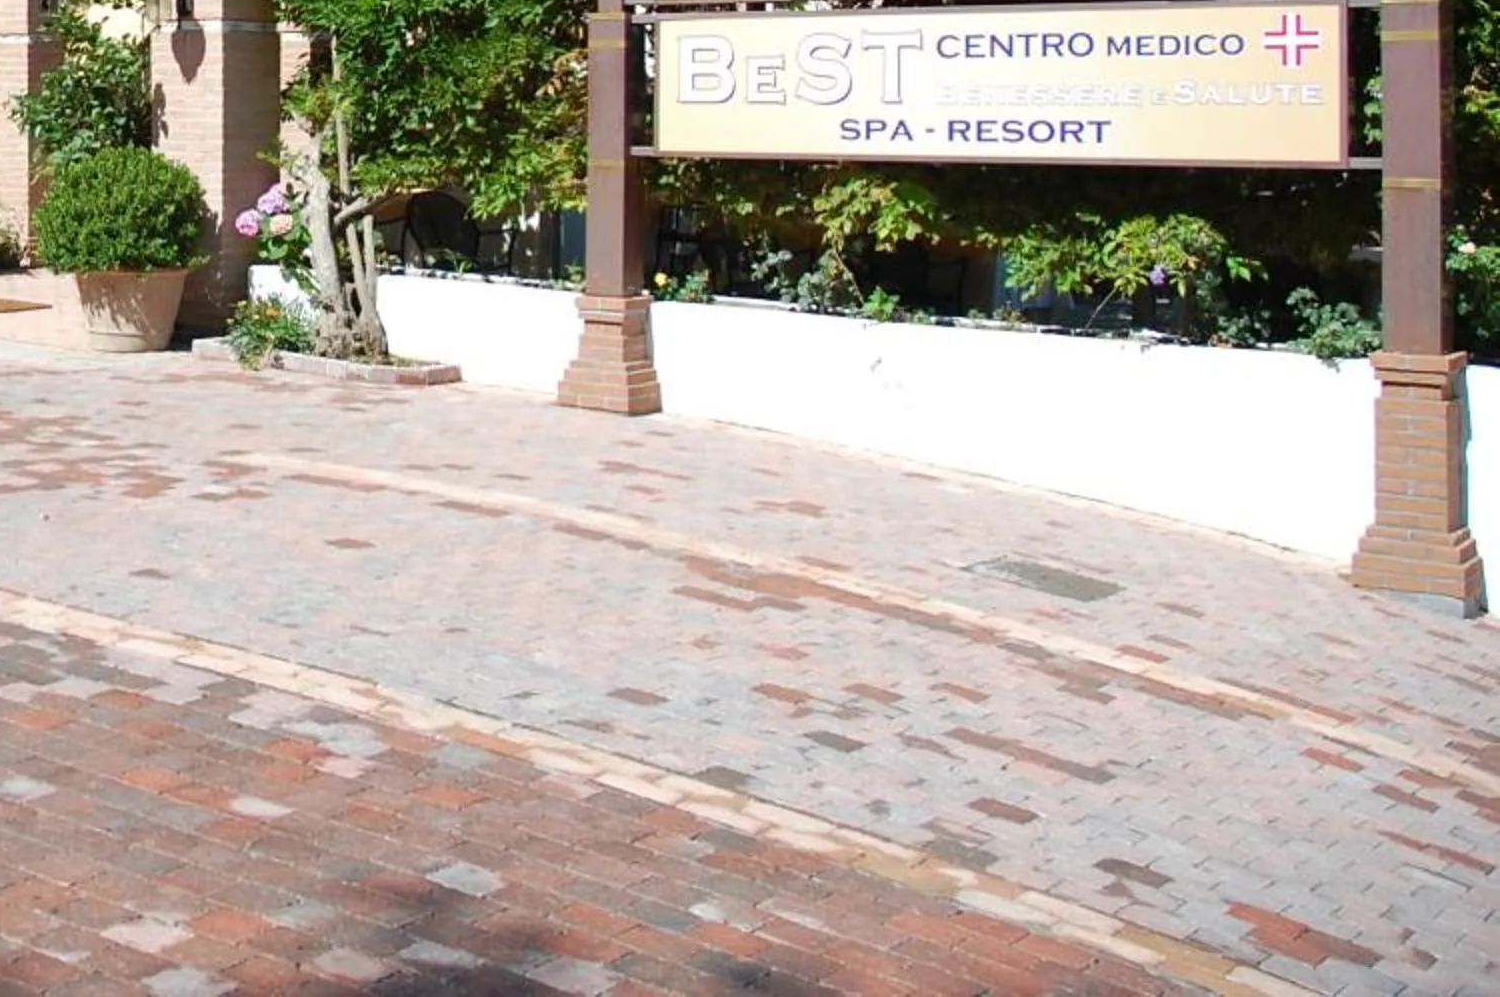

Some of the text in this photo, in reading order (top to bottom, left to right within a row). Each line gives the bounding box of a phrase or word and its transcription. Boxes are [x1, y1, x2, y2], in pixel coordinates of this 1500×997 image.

[936, 31, 1245, 59] CENTRO MEDICO
[1172, 80, 1324, 107] SALUTE
[840, 119, 914, 142] SPA
[948, 120, 1112, 143] RESORT
